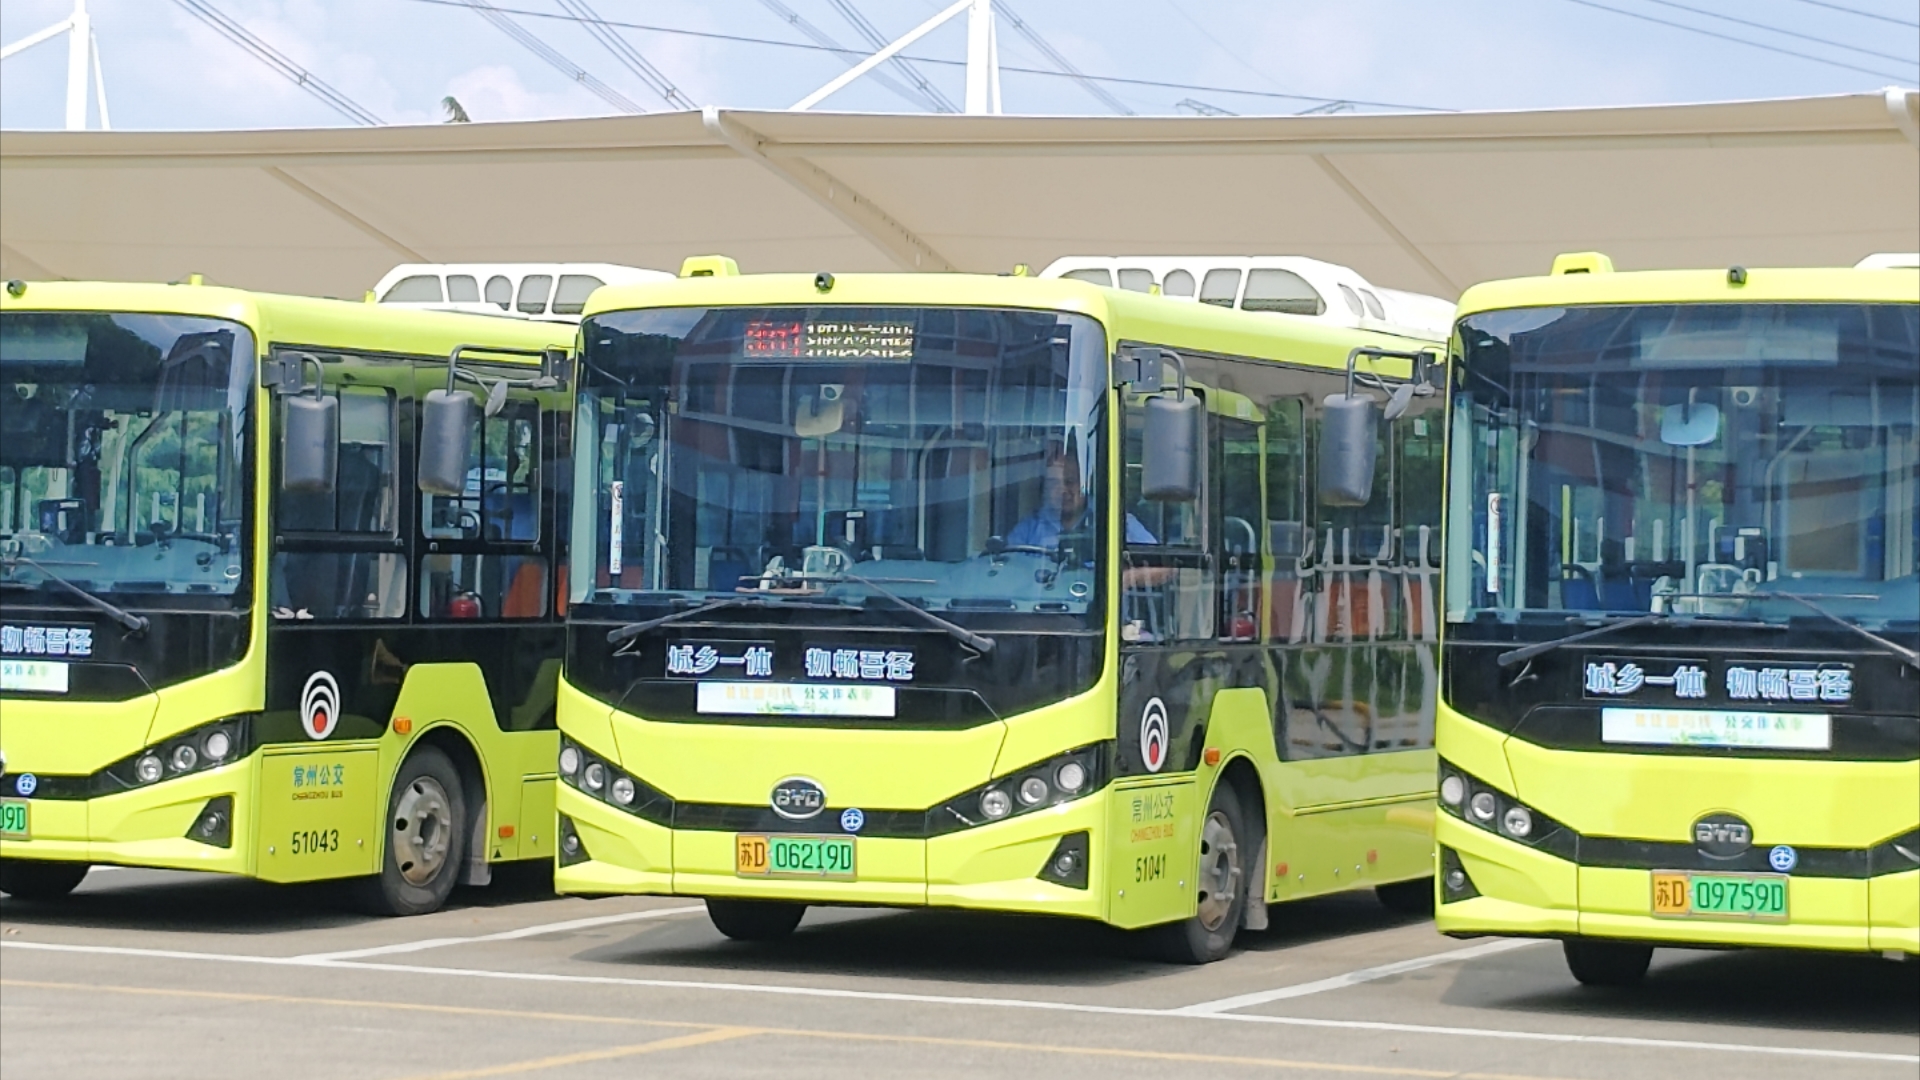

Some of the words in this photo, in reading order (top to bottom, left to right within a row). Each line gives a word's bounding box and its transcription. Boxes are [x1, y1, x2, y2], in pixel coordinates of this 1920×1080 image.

[0, 625, 93, 655] 物畅吾径
[667, 645, 772, 676] 城乡一体
[805, 648, 914, 679] 物畅吾径
[1586, 663, 1707, 697] 城乡一体
[1726, 667, 1851, 700] 物畅吾径
[294, 764, 344, 788] 常州公交
[776, 788, 820, 807] BYD
[1132, 791, 1174, 822] 常州公交
[292, 828, 339, 854] 51043
[1696, 823, 1748, 843] BYD
[1135, 853, 1166, 883] 51041
